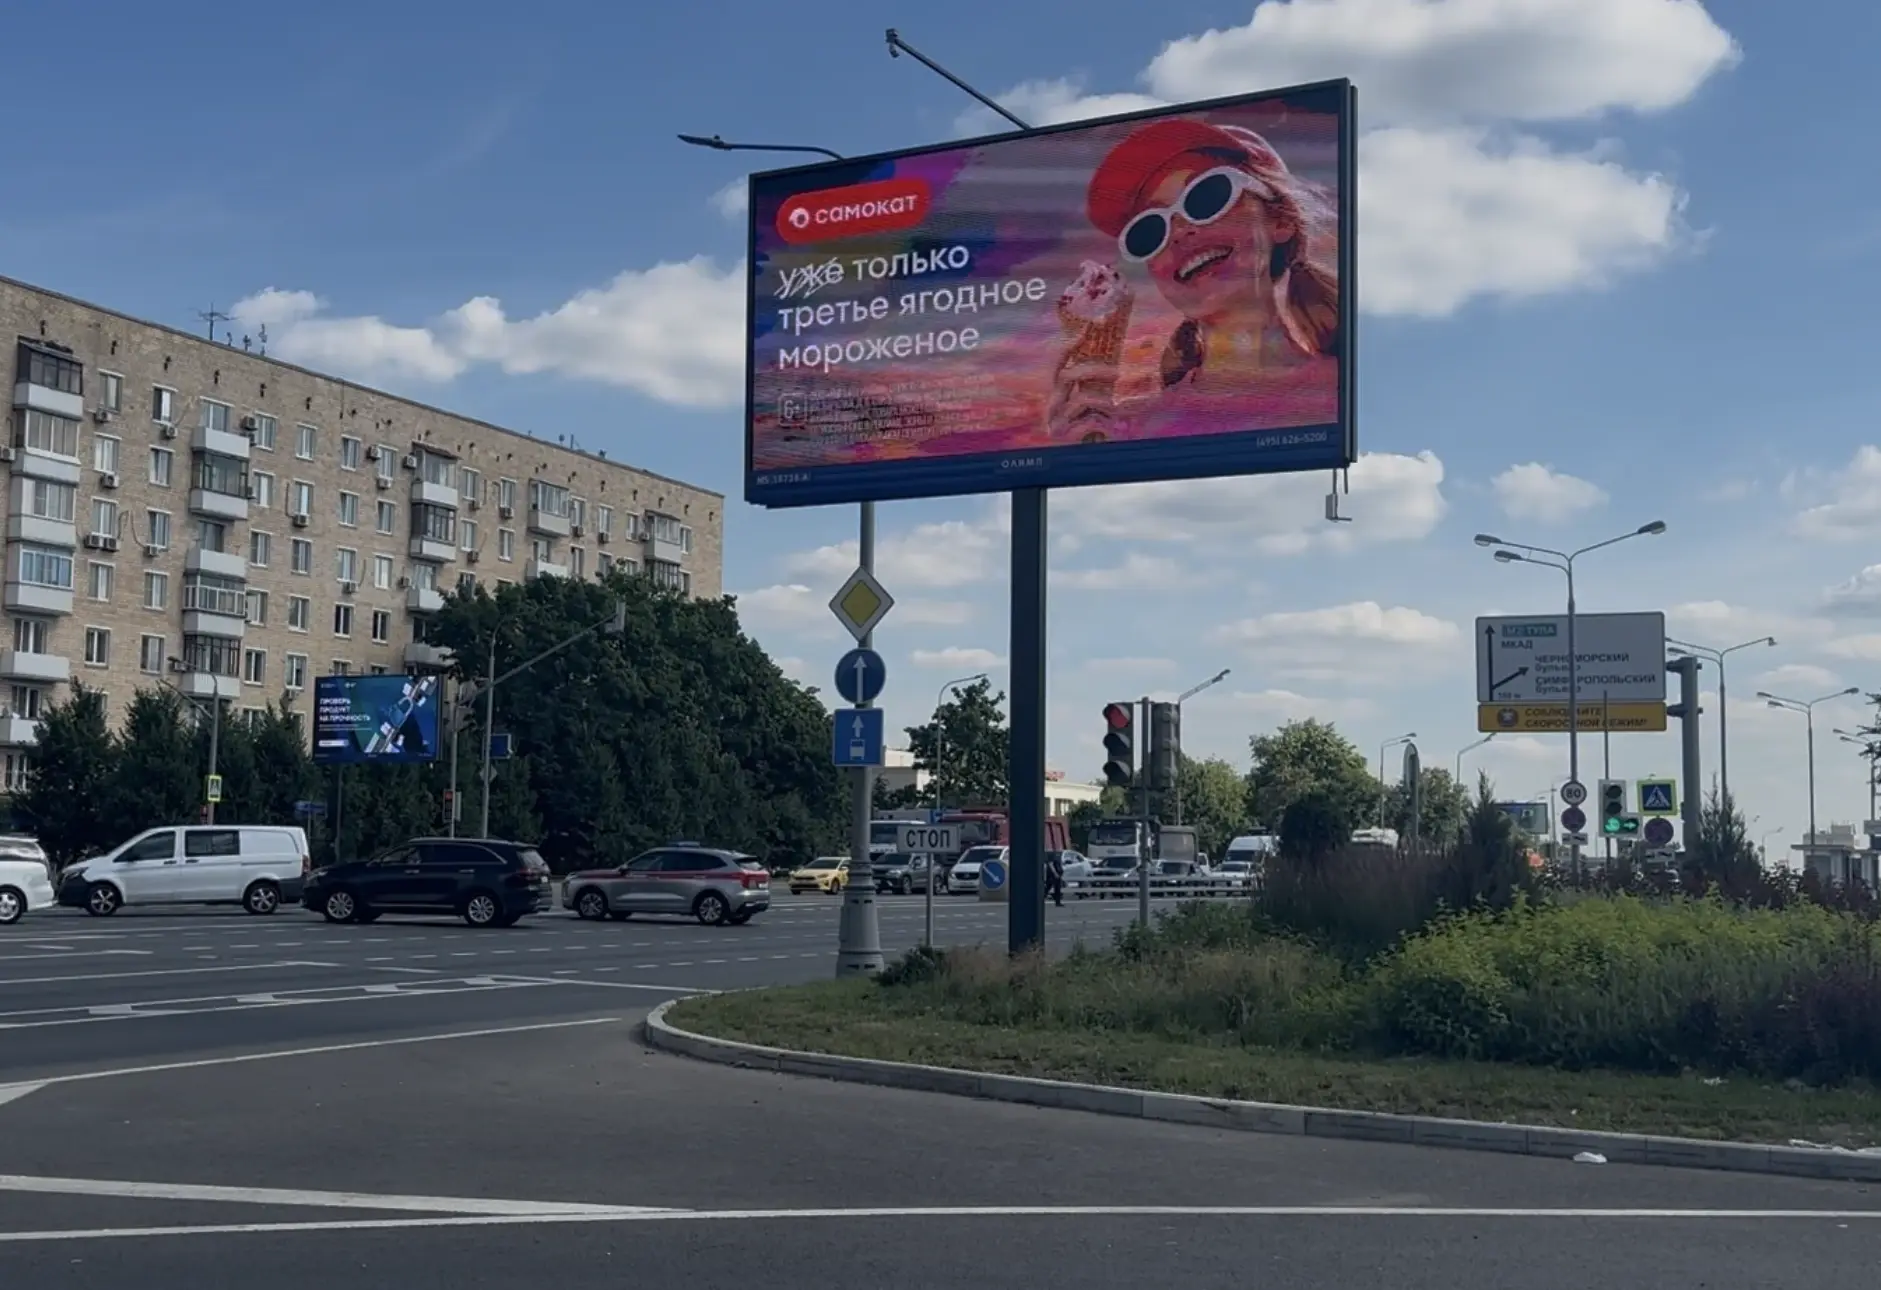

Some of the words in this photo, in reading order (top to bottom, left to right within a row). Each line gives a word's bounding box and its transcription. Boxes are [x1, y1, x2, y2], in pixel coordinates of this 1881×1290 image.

[815, 193, 918, 226] самокат
[775, 256, 845, 298] уже
[851, 245, 970, 281] только
[778, 296, 889, 335] третье
[898, 276, 1047, 317] ягодное
[778, 326, 981, 373] мороженое
[1001, 457, 1043, 468] ОЛИМП
[1526, 625, 1556, 636] ТУЛА
[1501, 639, 1533, 649] МКАД
[1535, 674, 1656, 685] СИМФРОПОЛЬСКИЙ
[319, 697, 351, 705] ПРОВЕРЬ
[1524, 707, 1602, 717] СОБЛЮАЙТЕ
[1524, 718, 1600, 728] СКОРОСНОЙ
[1566, 788, 1581, 799] 80
[906, 829, 950, 848] СТОП
